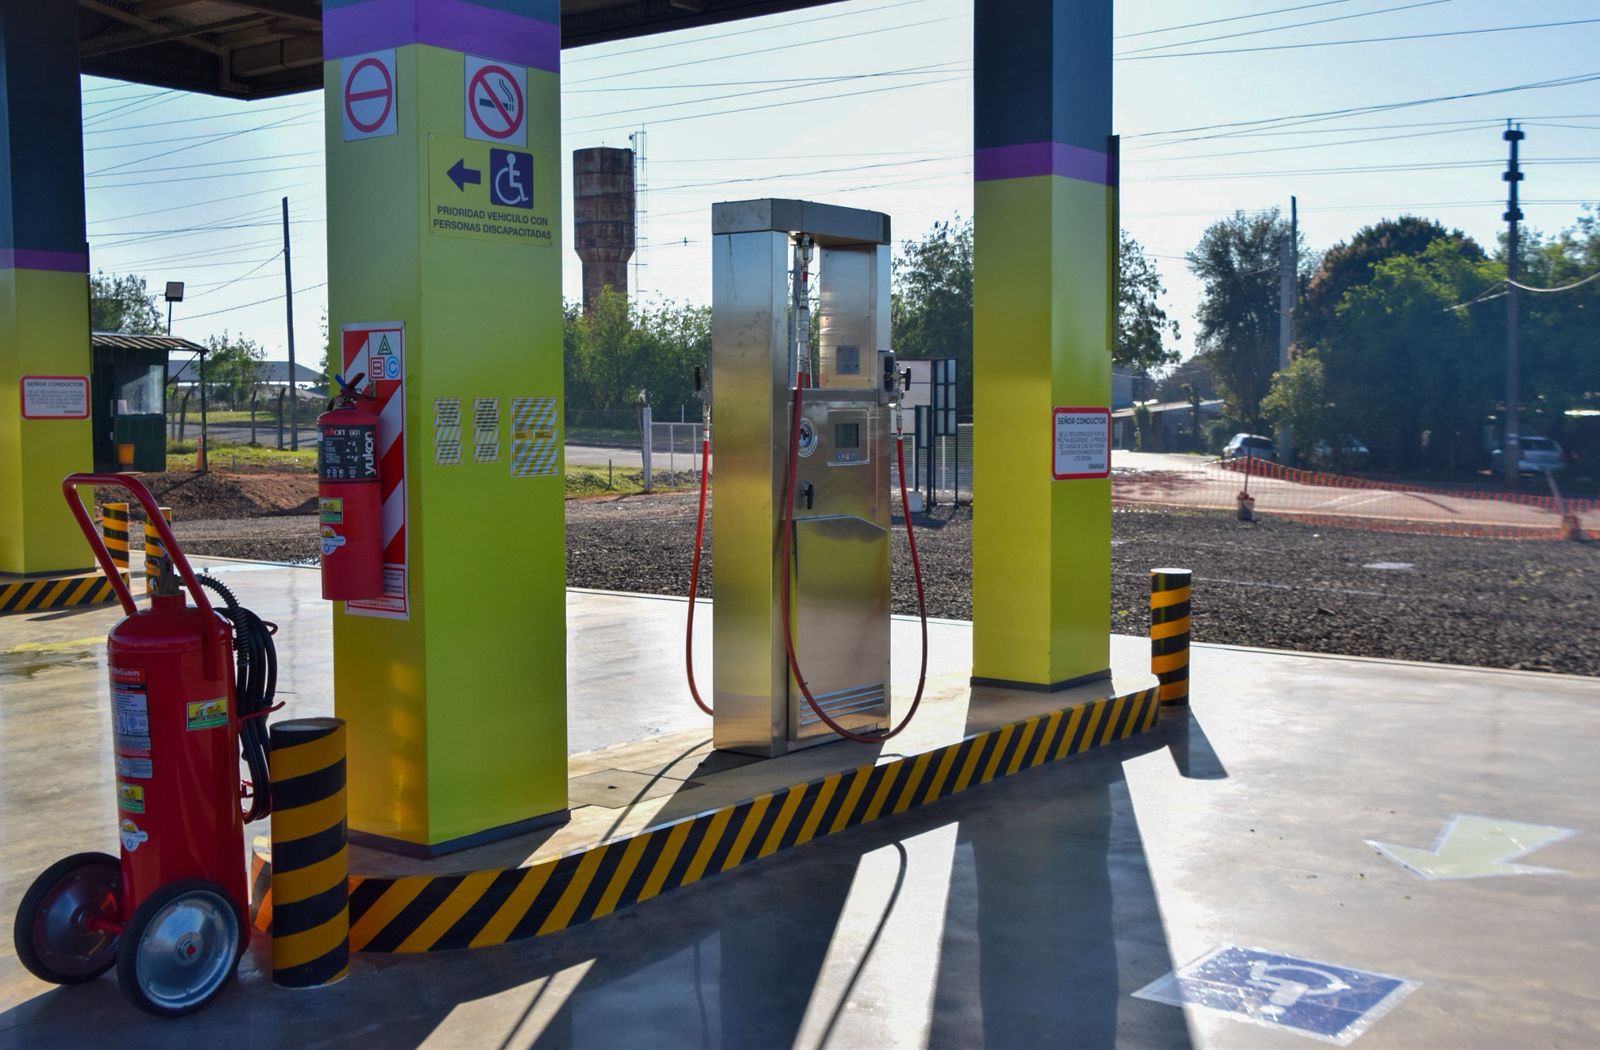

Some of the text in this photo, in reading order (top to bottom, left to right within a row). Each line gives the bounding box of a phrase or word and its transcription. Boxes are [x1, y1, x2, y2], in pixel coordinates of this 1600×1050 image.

[437, 205, 548, 226] PRIORIDAD VEHICULO CON
[433, 219, 552, 240] PERSONAS DISCAPACITADAS
[1076, 417, 1106, 425] CONDUCTOR
[362, 431, 376, 475] yukon
